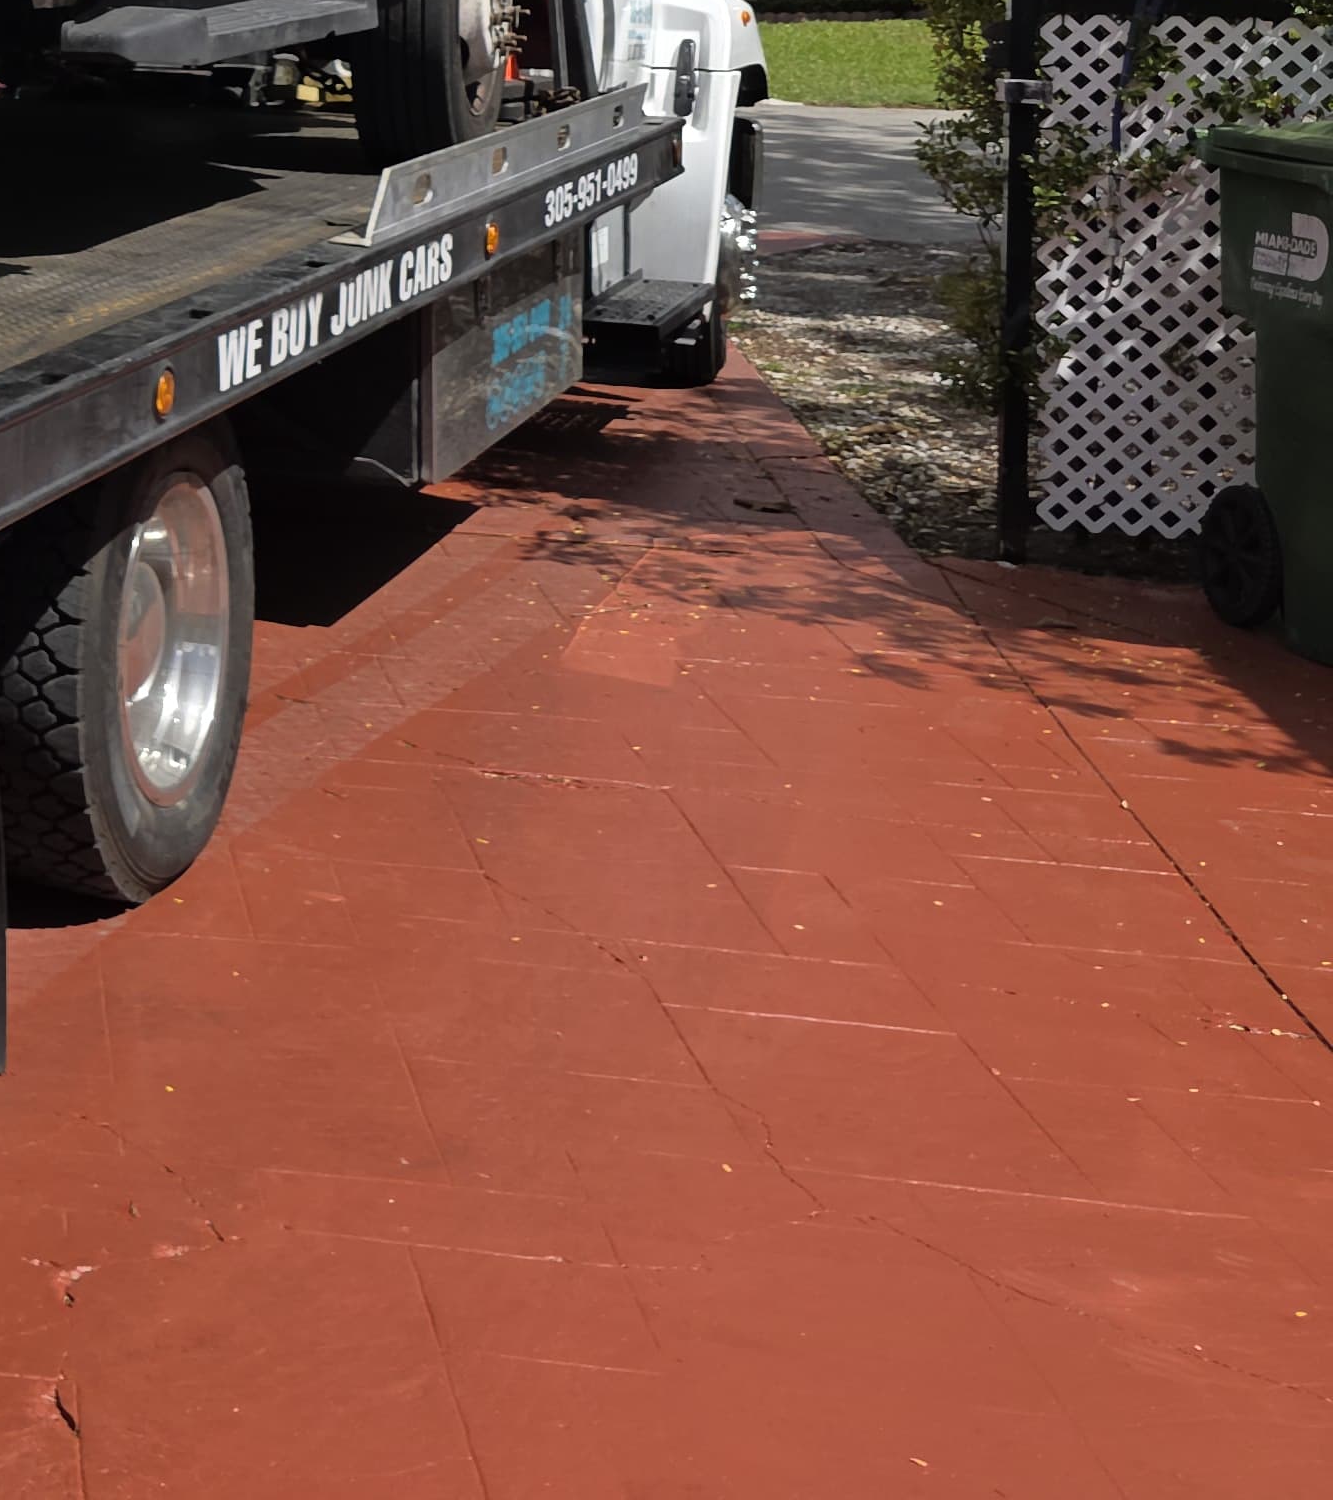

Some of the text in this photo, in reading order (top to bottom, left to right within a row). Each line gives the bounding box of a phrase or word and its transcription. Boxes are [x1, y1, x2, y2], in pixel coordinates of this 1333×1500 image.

[543, 152, 639, 228] 305-951-0499
[1254, 231, 1317, 258] MIAMI-DADE
[217, 232, 455, 392] WE BUY JUNK CARS
